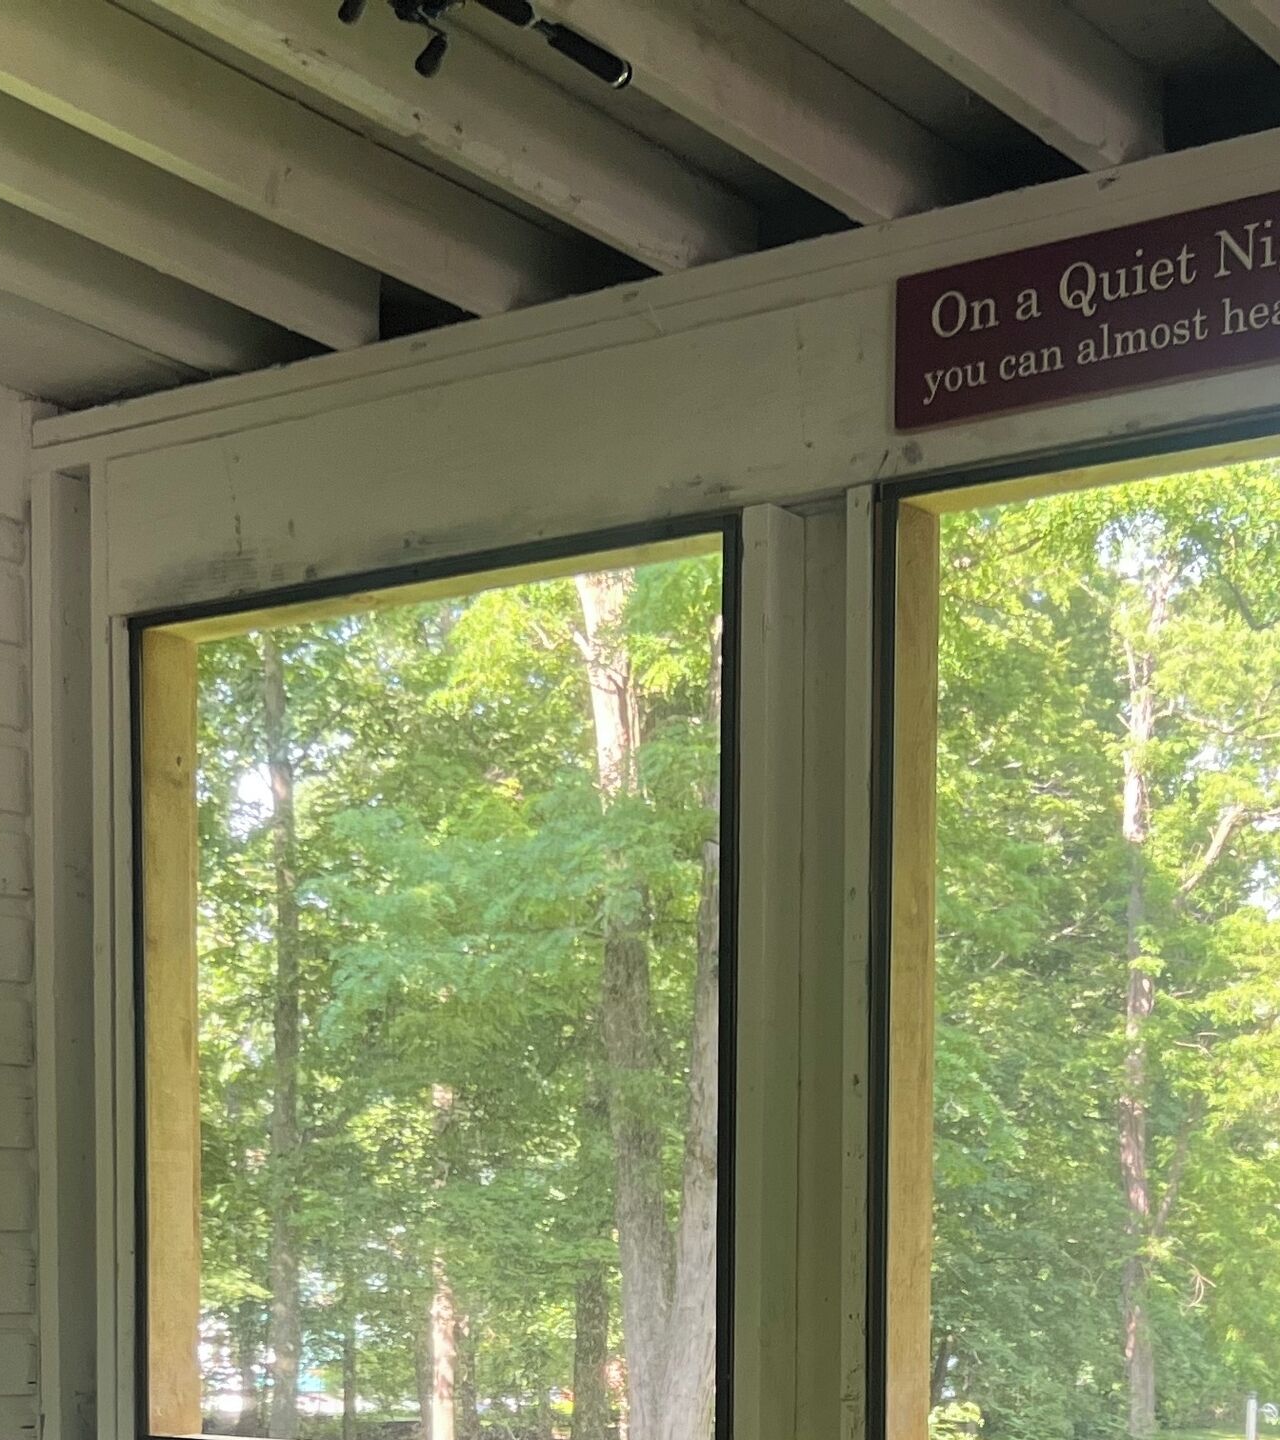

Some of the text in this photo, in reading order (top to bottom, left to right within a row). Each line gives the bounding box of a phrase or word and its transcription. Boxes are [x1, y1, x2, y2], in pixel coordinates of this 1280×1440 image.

[931, 290, 999, 338] On
[1015, 288, 1041, 321] a
[1059, 244, 1197, 317] Quiet
[923, 359, 986, 405] you
[999, 346, 1064, 381] can
[1077, 308, 1209, 366] almost
